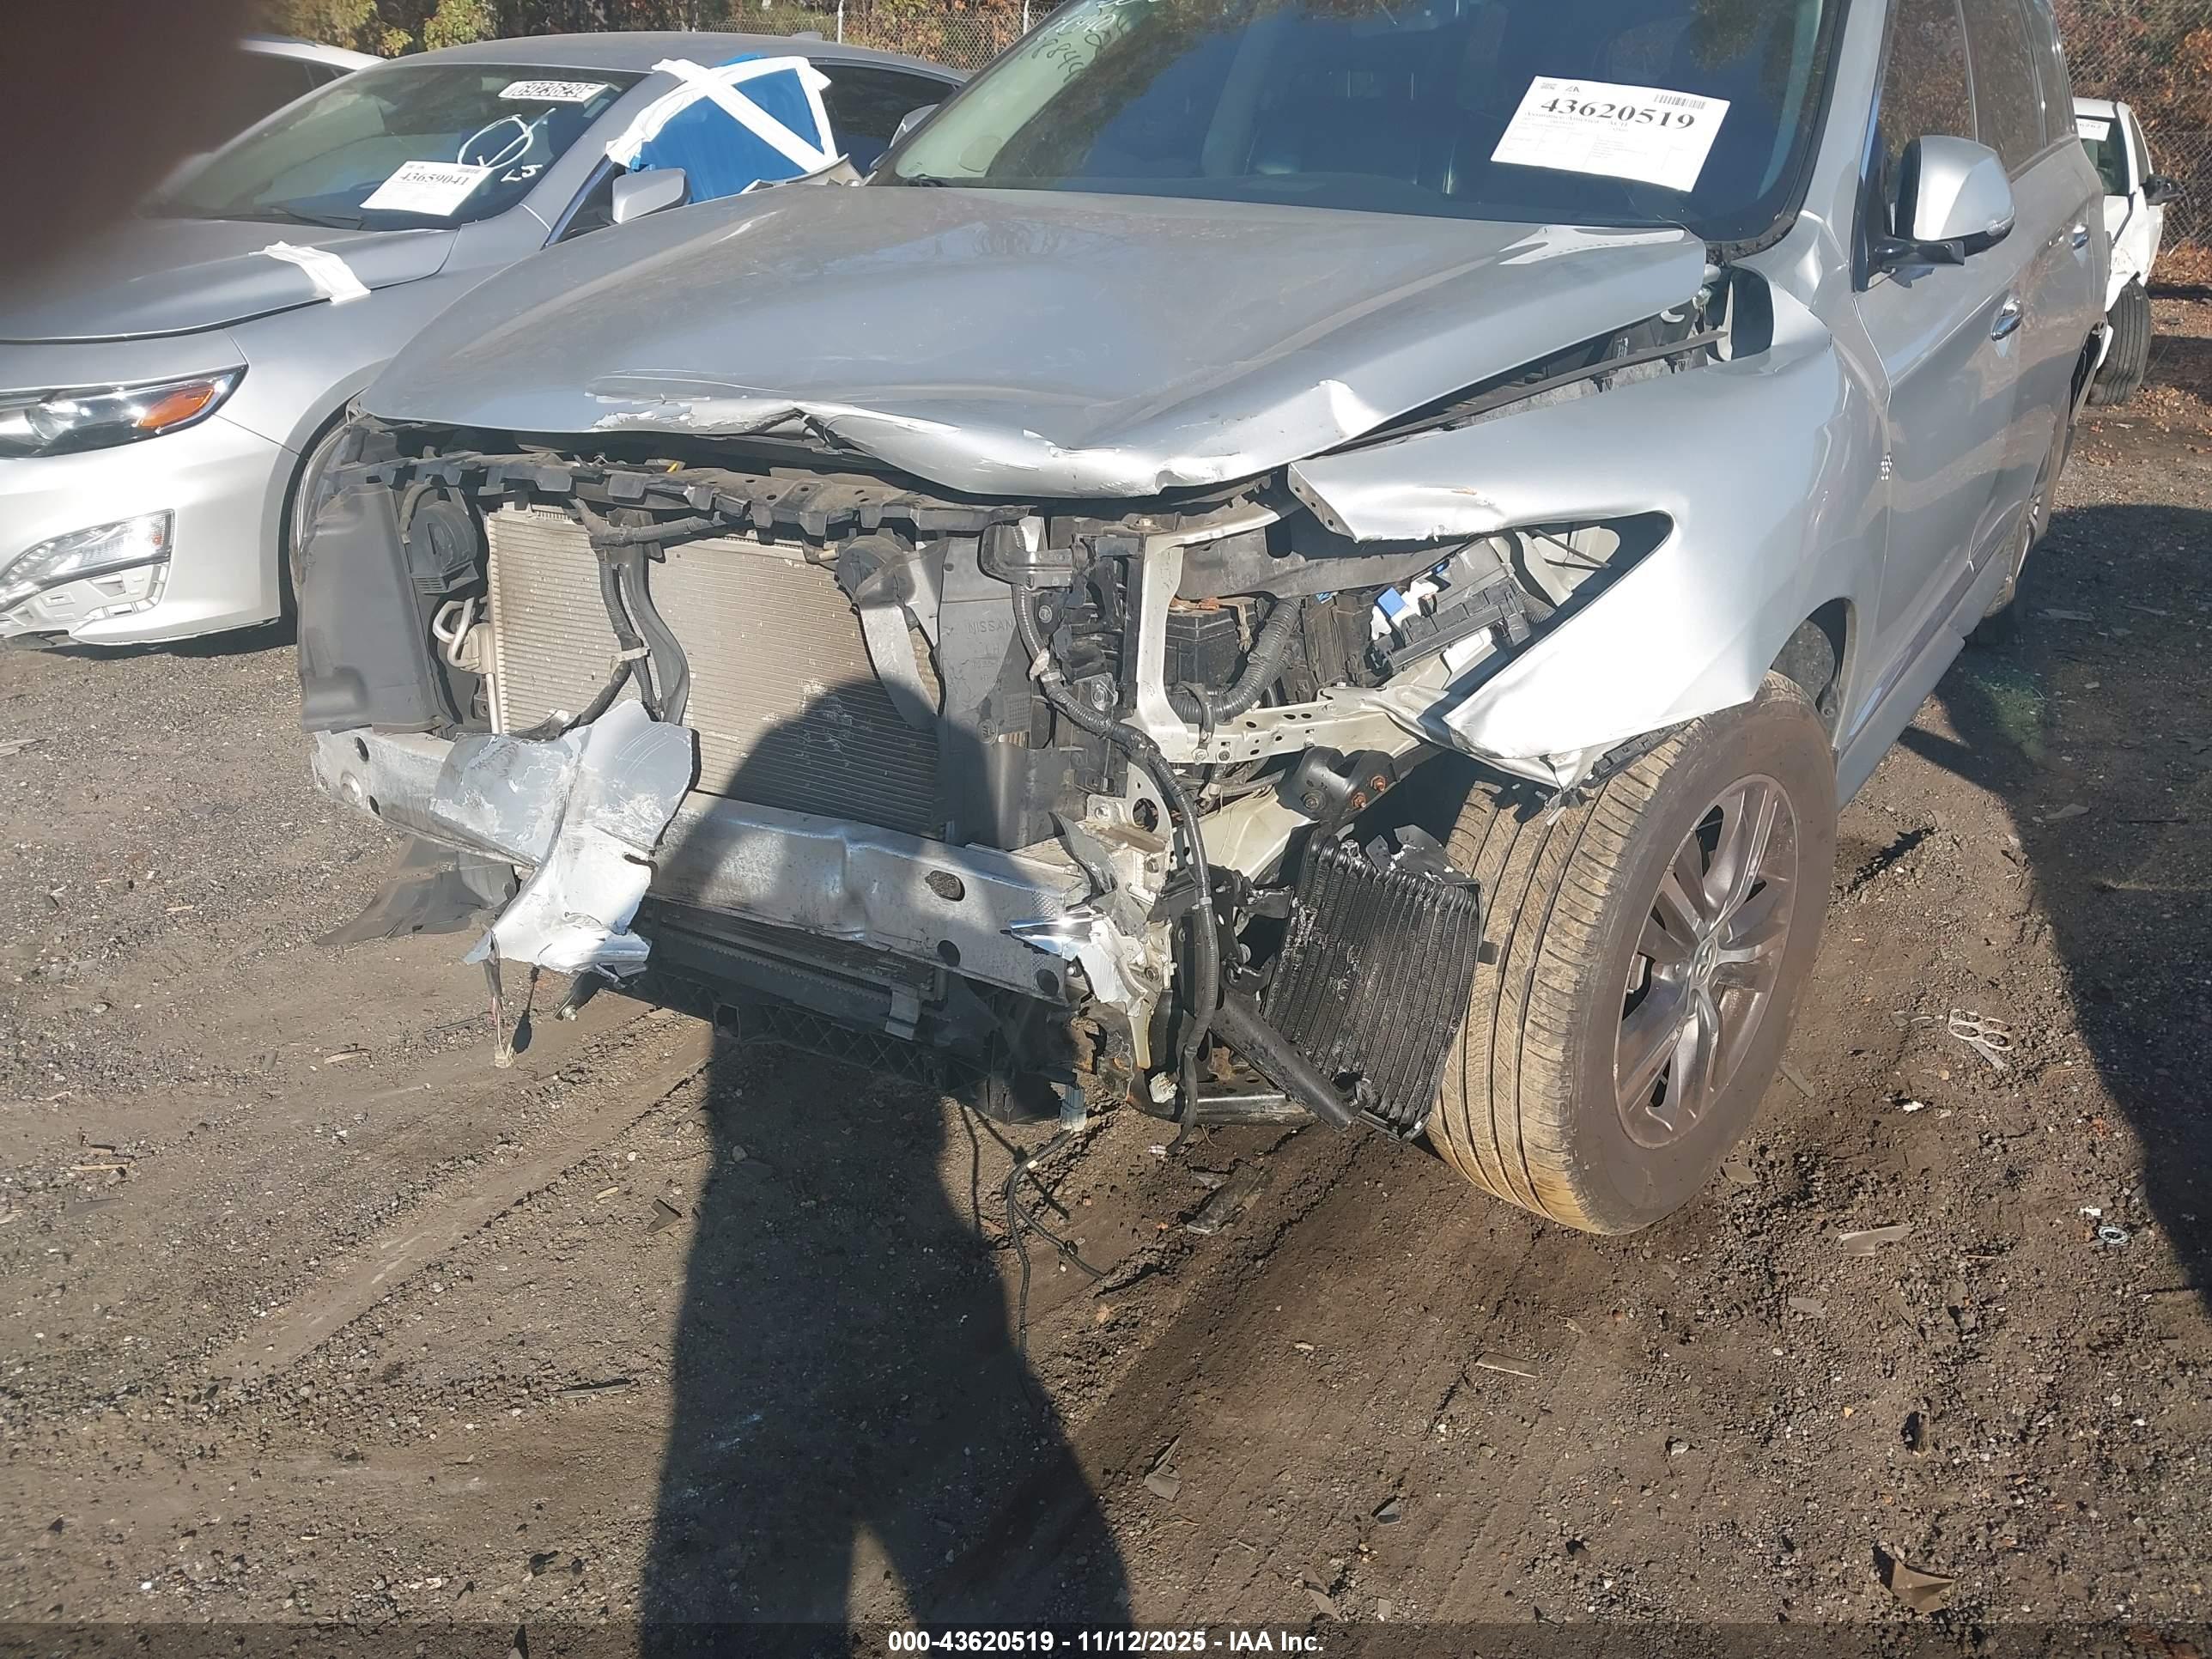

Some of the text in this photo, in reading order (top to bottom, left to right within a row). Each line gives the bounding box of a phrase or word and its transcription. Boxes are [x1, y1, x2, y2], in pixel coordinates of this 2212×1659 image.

[1540, 98, 1696, 129] 43620519
[400, 172, 470, 186] 43659041
[968, 619, 1013, 635] NISSAN
